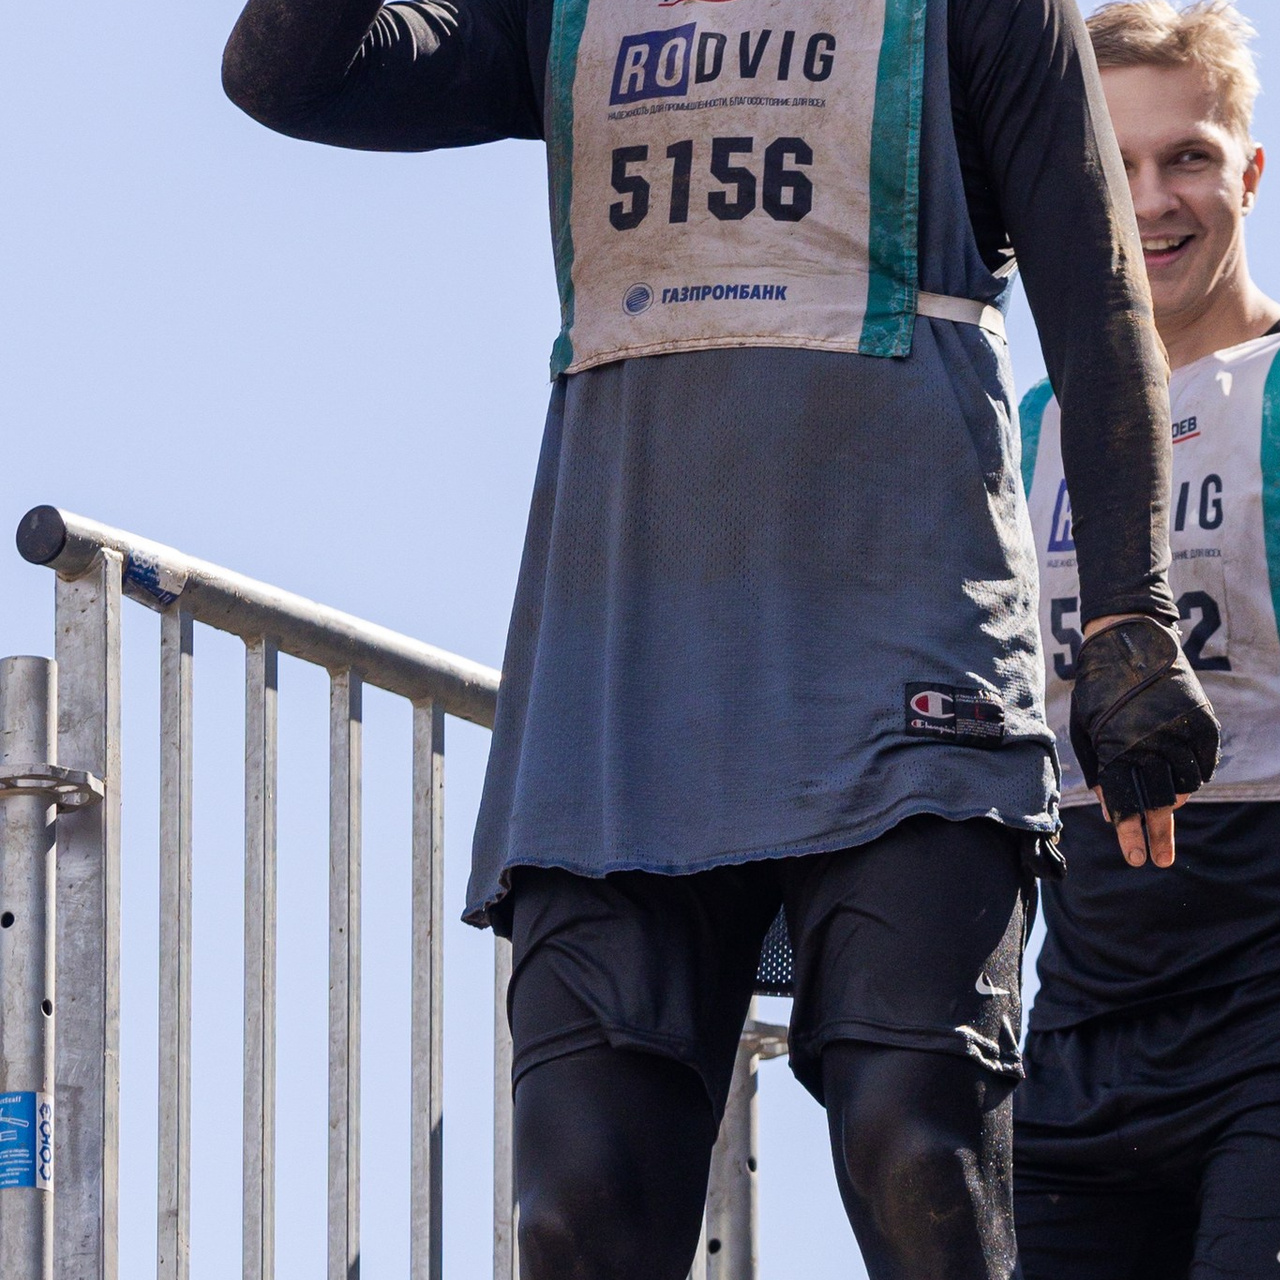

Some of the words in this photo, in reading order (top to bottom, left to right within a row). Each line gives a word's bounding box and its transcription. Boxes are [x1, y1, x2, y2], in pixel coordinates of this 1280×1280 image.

[619, 29, 837, 95] RODVIG
[792, 98, 808, 107] ДЛЯ
[808, 99, 826, 108] ВСЕХ
[608, 136, 814, 231] 5156
[661, 284, 788, 304] ГАЗПРОМБАНК
[1172, 416, 1197, 439] ОЕВ
[911, 719, 957, 735] Champion
